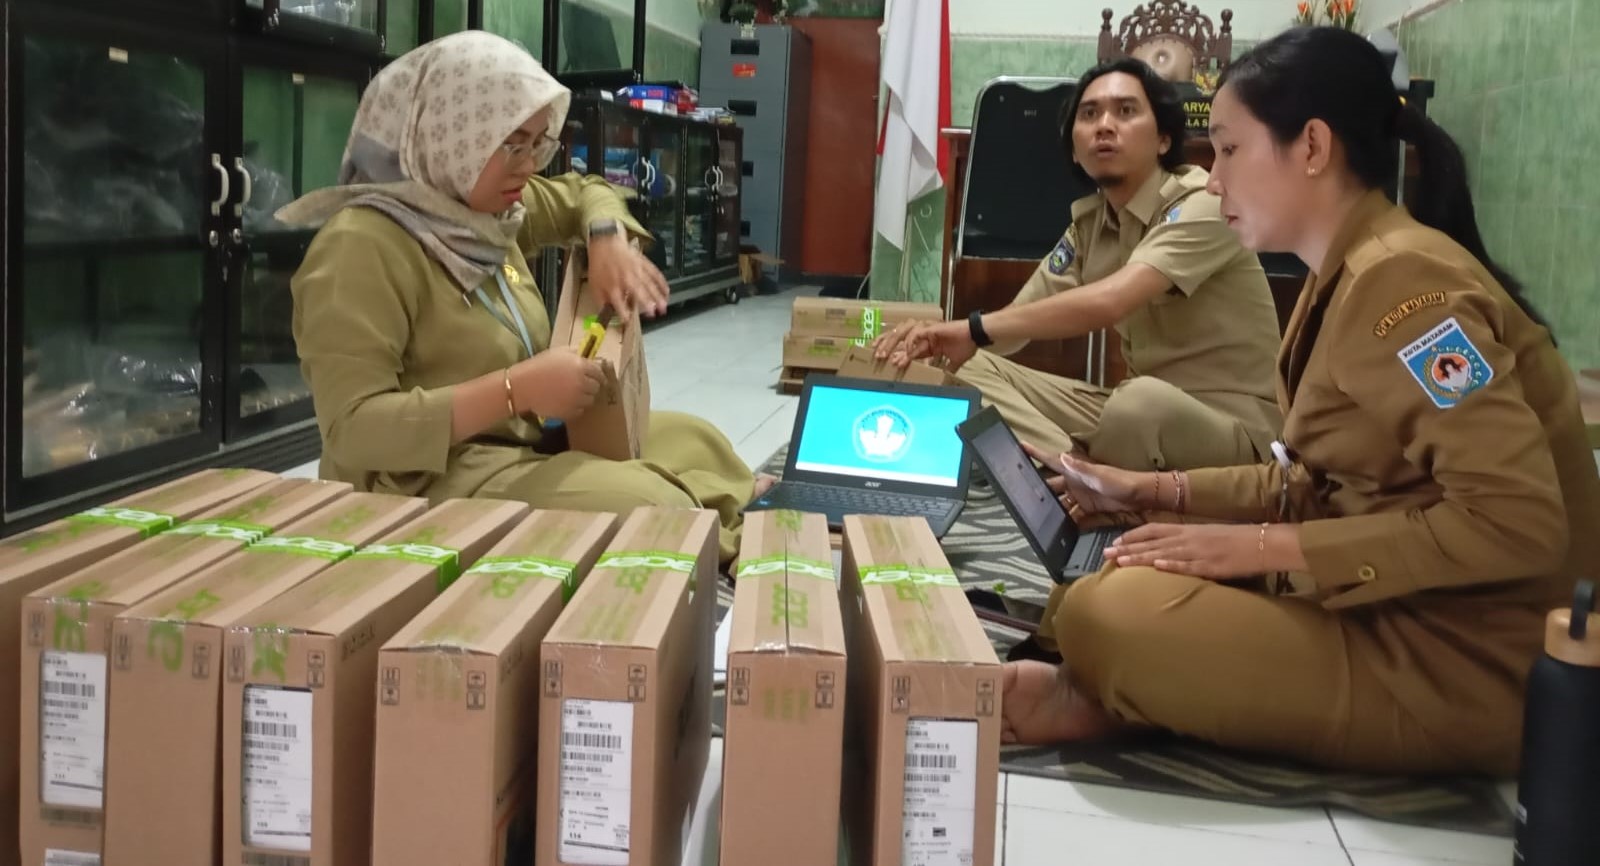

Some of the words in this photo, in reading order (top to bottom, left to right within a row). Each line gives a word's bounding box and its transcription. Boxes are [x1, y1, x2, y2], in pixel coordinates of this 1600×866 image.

[1185, 118, 1200, 128] LA
[1402, 344, 1422, 358] KOTA
[1420, 322, 1454, 347] MATARAM
